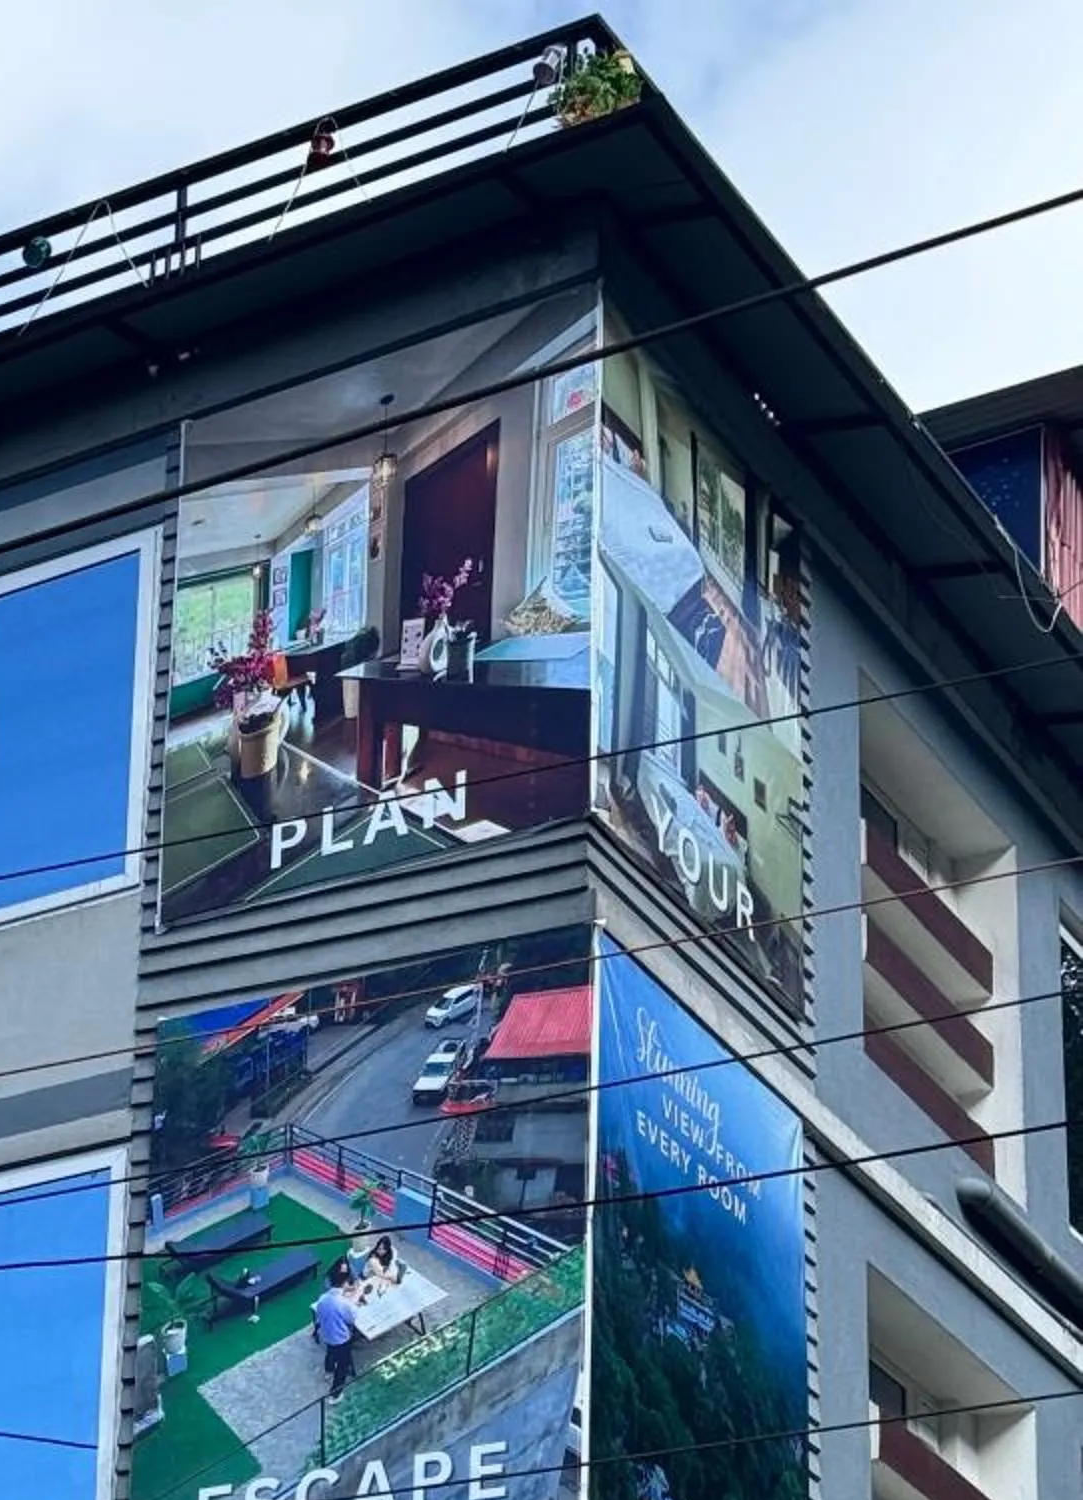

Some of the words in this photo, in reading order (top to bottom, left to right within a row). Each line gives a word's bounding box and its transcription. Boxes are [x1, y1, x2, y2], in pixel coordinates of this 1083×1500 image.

[270, 771, 467, 869] PLAN
[652, 800, 756, 942] YOUR
[635, 1006, 721, 1153] Stunning
[636, 1110, 692, 1179] EVERY
[697, 1164, 747, 1228] ROOM
[715, 1143, 762, 1202] FROM
